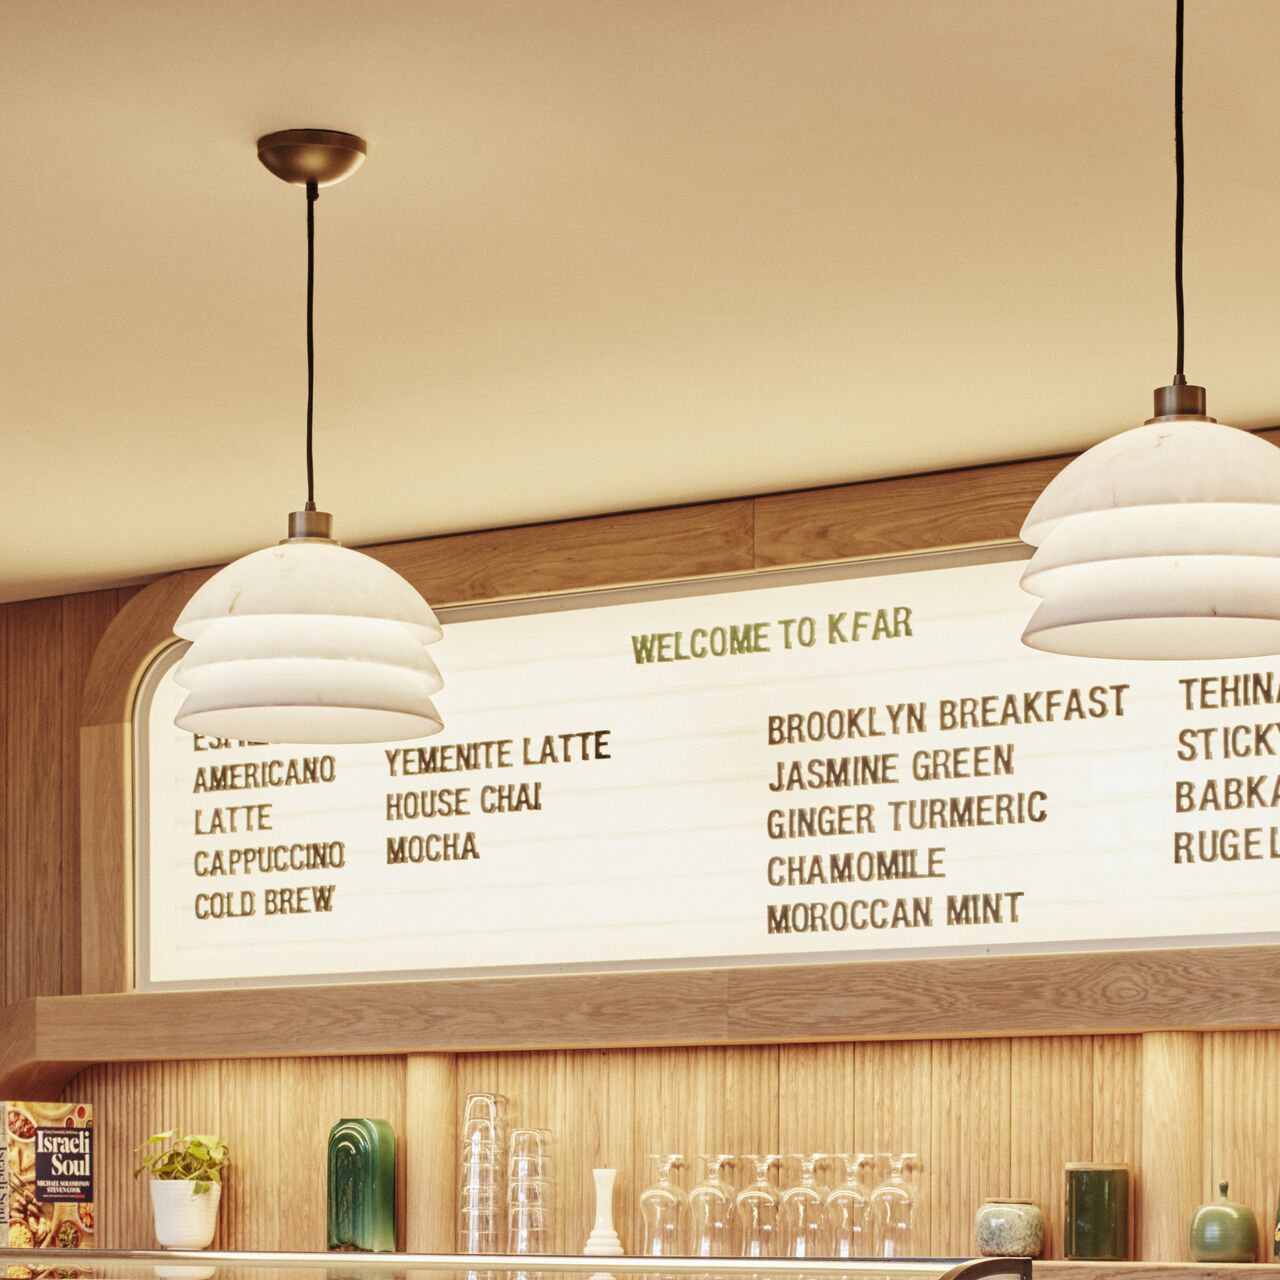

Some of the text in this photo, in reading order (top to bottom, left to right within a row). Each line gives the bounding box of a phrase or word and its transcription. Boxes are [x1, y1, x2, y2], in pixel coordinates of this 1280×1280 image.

[632, 607, 912, 664] WELCOME TO KFAR
[768, 684, 1130, 745] BROOKLYN BREAKFAST
[385, 730, 611, 776] YEMENITE LATTE
[769, 744, 1014, 792] JASMINE GREEN
[193, 755, 336, 793] AMERICANO
[195, 804, 272, 835] LATTE
[387, 782, 541, 821] HOUSE CHAI
[767, 791, 1047, 839] GINGER TURMERIC
[194, 841, 345, 877] CAPPUCCINO
[387, 832, 480, 864] MOCHA
[768, 848, 945, 886] CHAMOMILE
[195, 885, 336, 920] COLD BREW
[767, 892, 1024, 934] MOROCCAN MINT
[37, 1130, 90, 1153] Israeli
[51, 1153, 90, 1175] Soul
